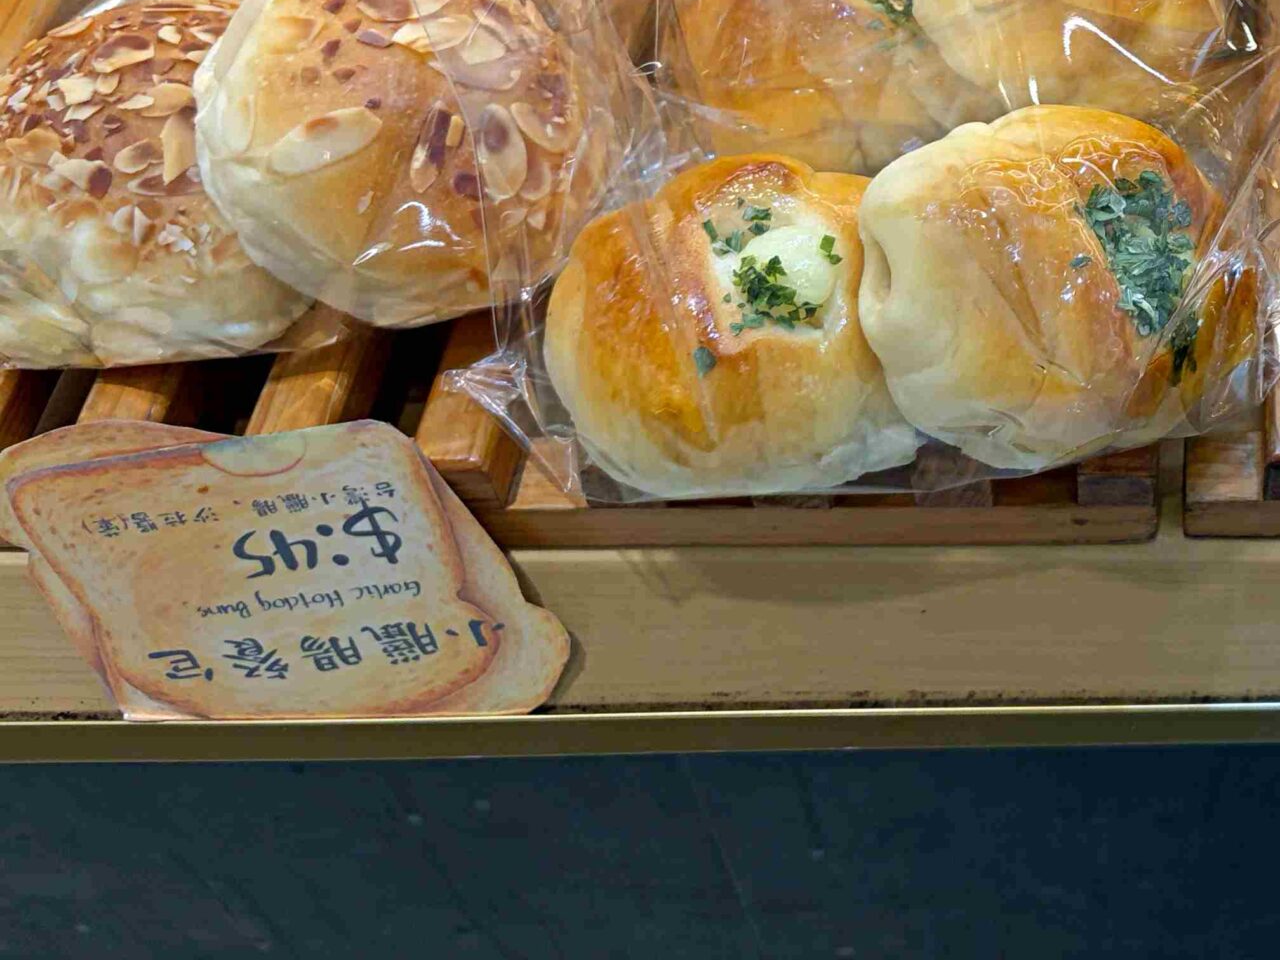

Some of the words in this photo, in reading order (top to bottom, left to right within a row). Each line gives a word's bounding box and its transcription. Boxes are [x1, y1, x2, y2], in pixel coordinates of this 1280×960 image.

[255, 587, 345, 612] Hotdog
[349, 580, 421, 599] Garlic
[147, 620, 505, 682] 小臘腸餐包
